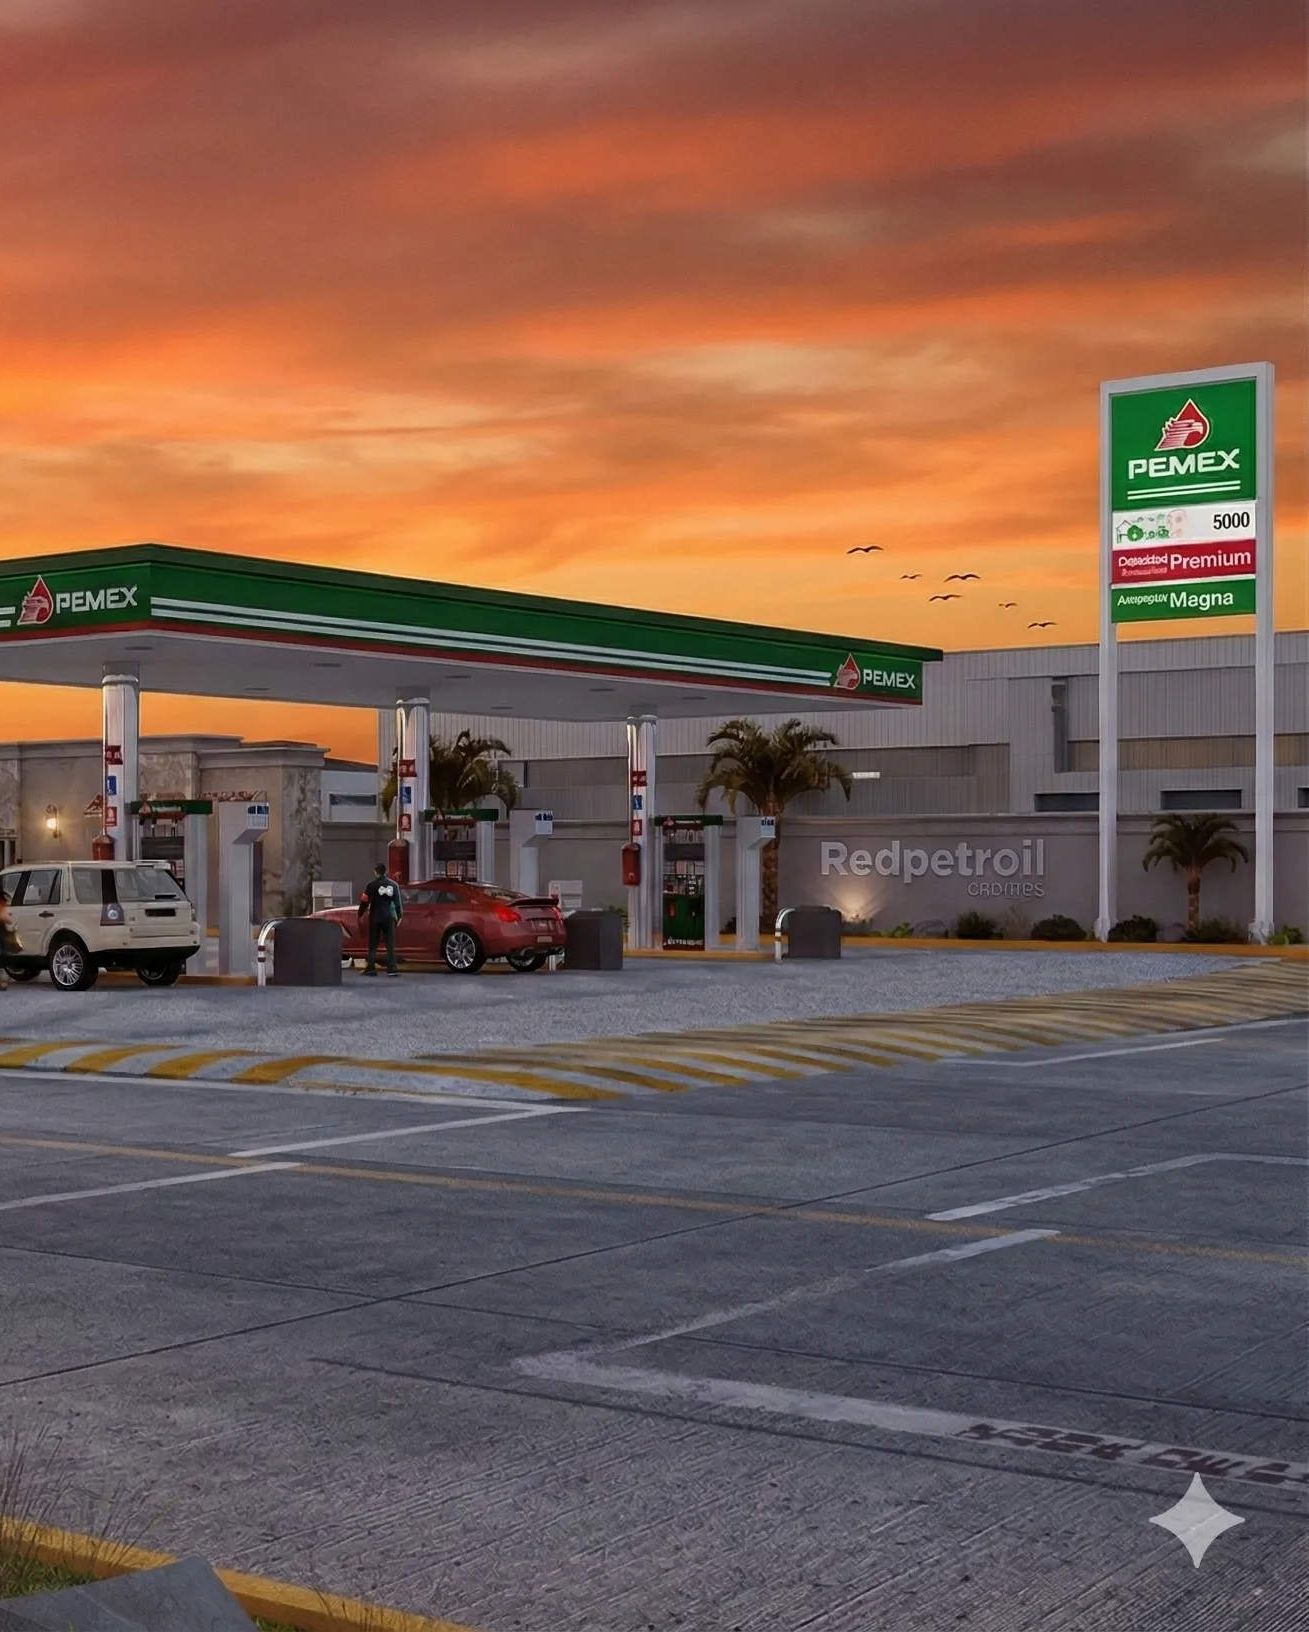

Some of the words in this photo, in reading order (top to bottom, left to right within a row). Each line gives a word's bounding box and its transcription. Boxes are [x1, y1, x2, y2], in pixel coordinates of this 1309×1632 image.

[1128, 448, 1240, 480] PEMEX
[1213, 511, 1250, 530] 5000
[1170, 550, 1251, 570] Premium
[55, 584, 138, 614] PEMEX
[1169, 591, 1234, 611] Magna
[862, 668, 916, 690] PEMEX
[820, 838, 1044, 884] Redpetroil
